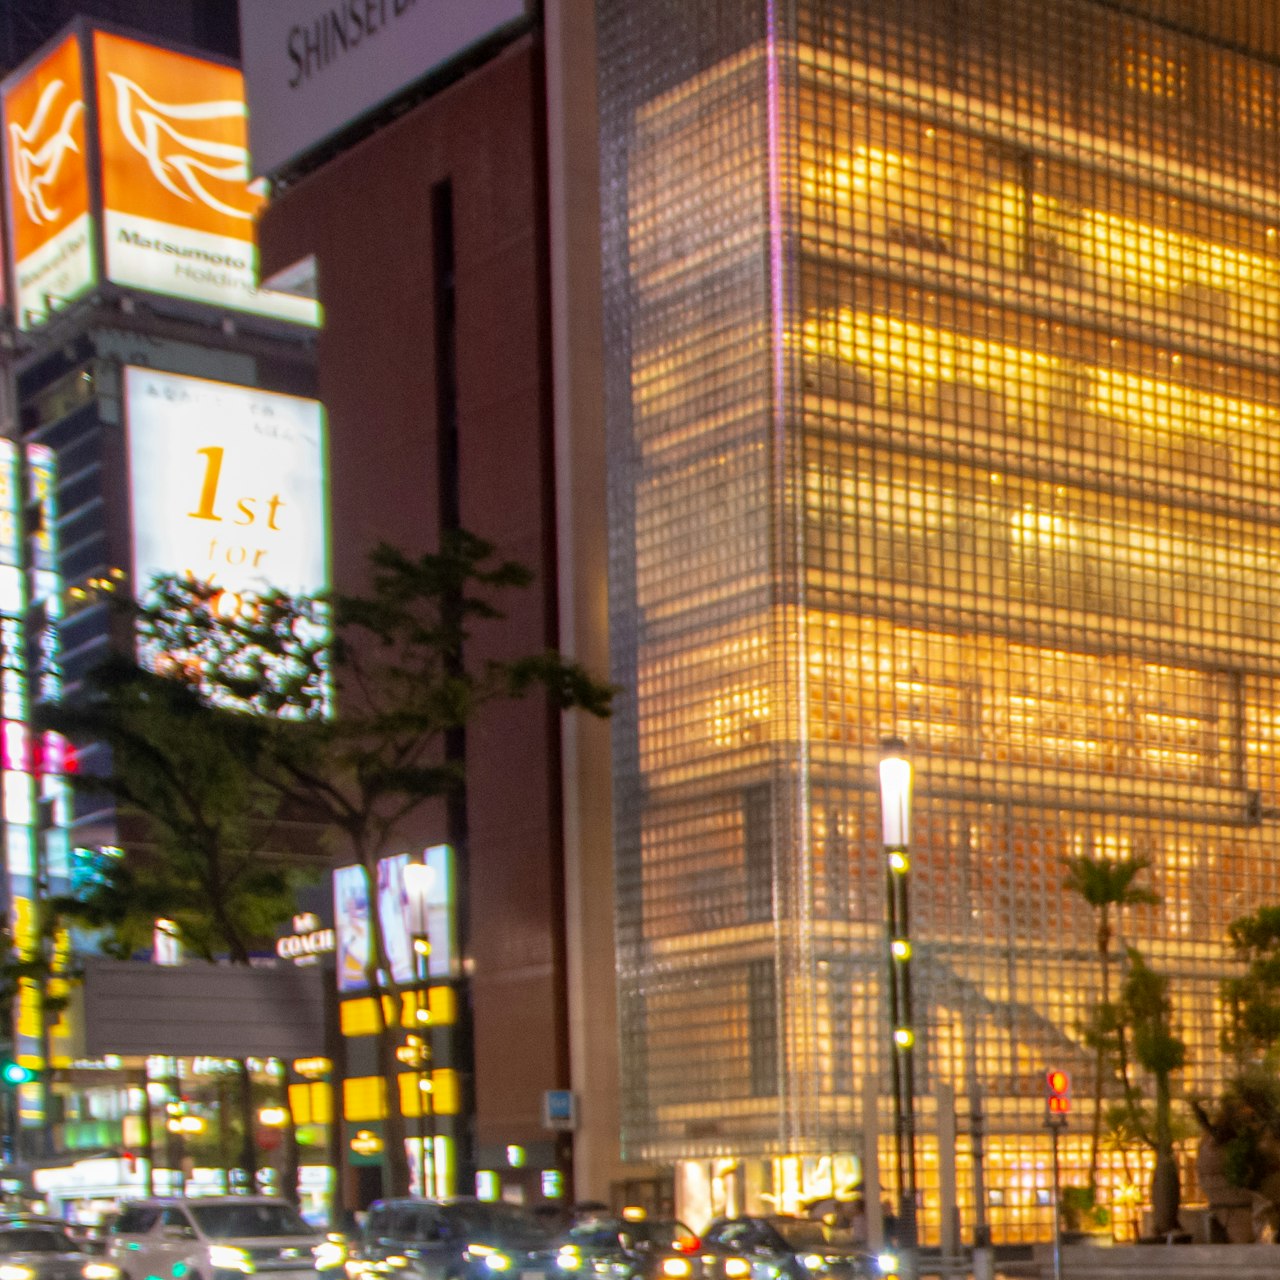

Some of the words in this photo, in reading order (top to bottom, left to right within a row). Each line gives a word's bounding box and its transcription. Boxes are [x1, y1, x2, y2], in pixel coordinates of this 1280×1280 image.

[117, 226, 247, 269] Matsumoto
[186, 445, 288, 532] 1st
[208, 536, 269, 569] for
